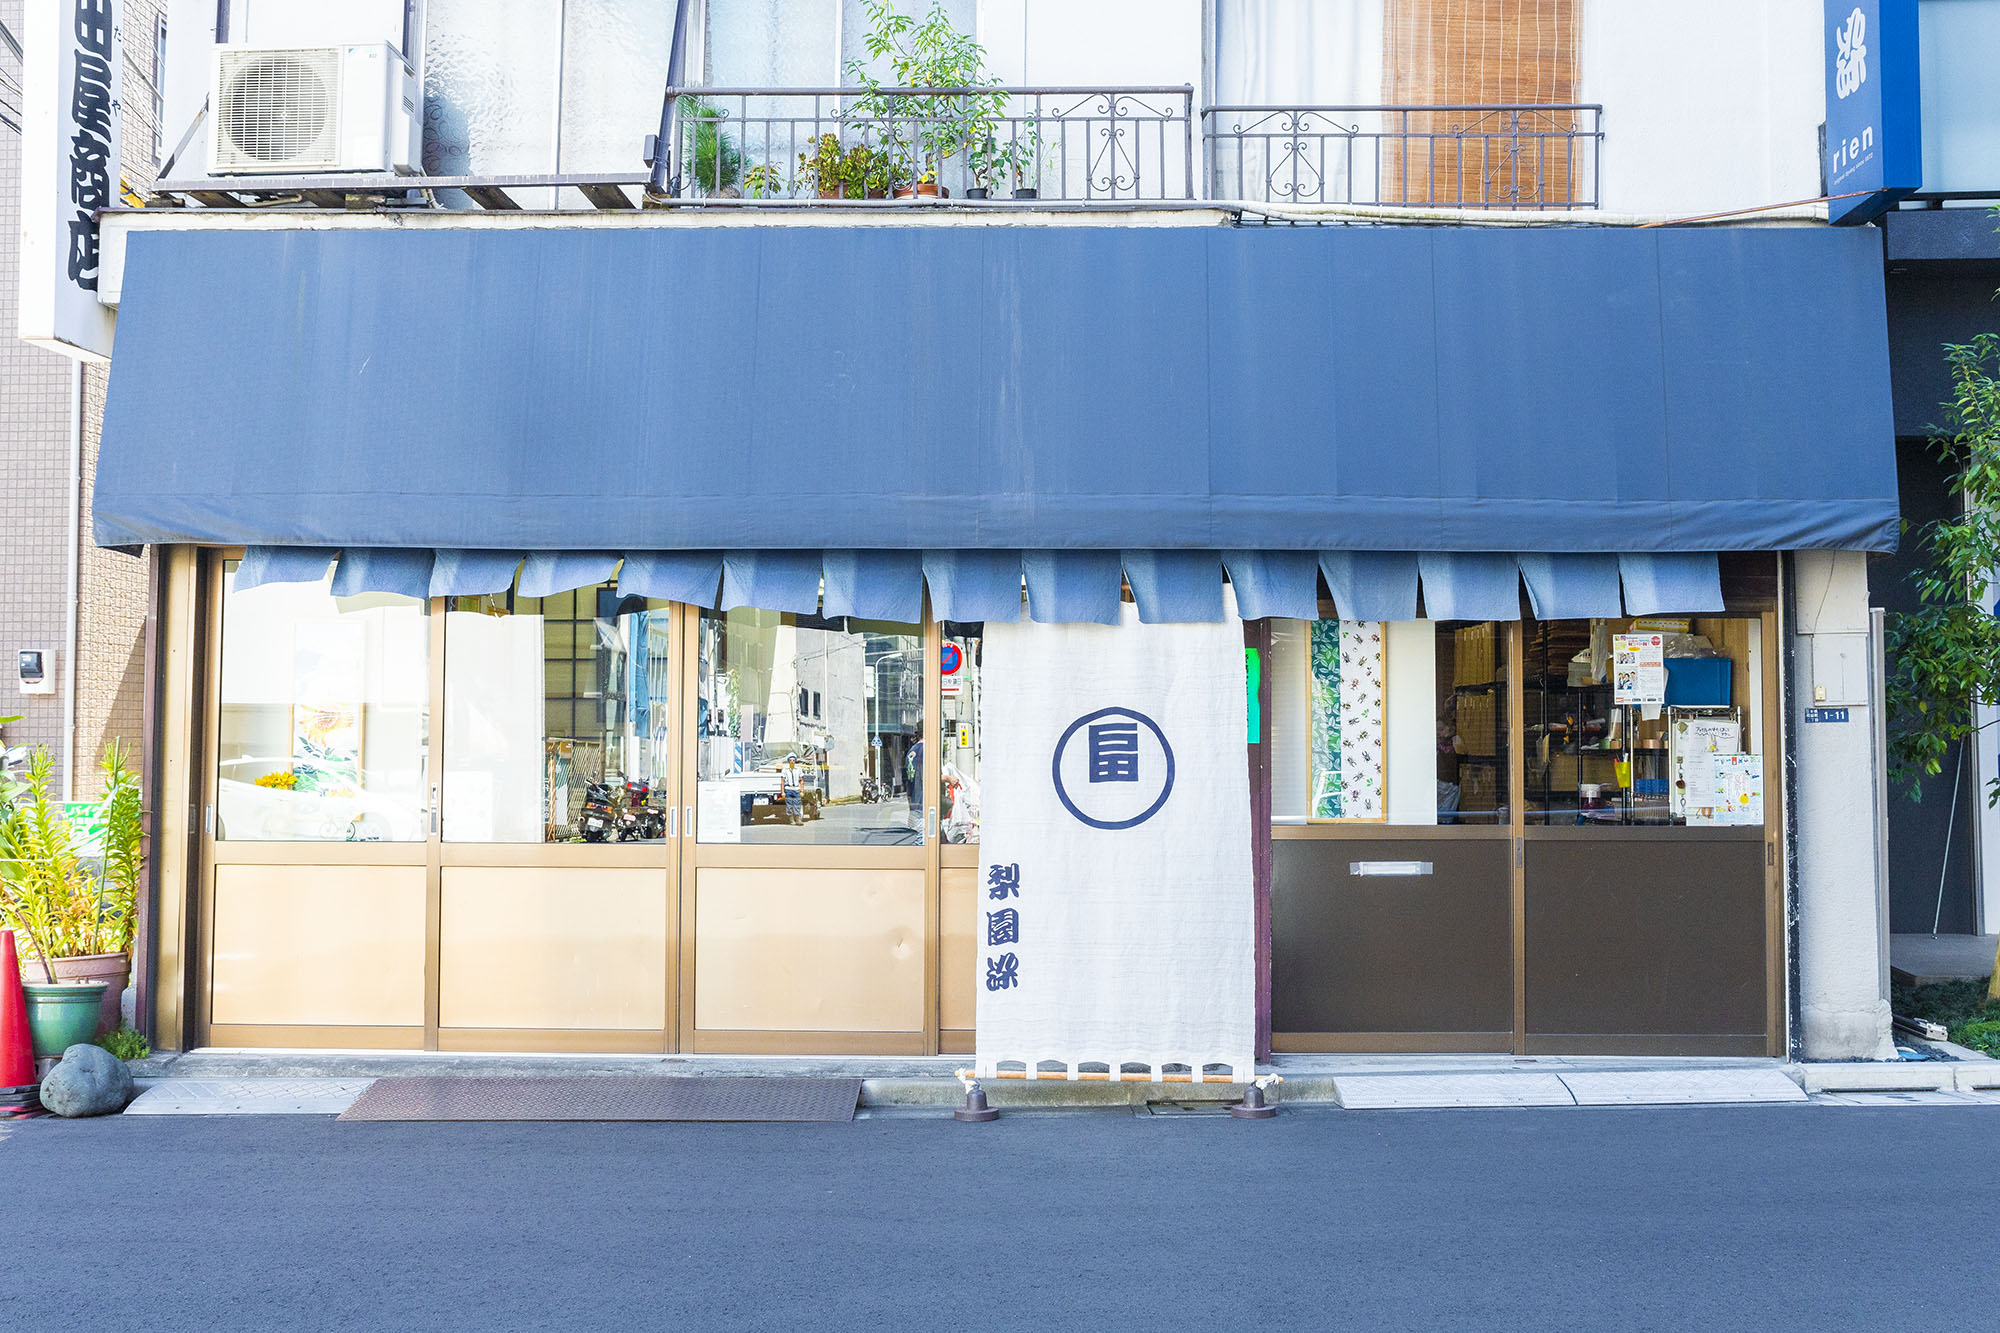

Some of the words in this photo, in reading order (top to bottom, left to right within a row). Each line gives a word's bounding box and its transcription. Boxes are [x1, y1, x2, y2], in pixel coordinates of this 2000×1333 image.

[1833, 126, 1873, 174] rien
[1824, 711, 1845, 720] 1-11
[986, 862, 1020, 992] 梨園染
